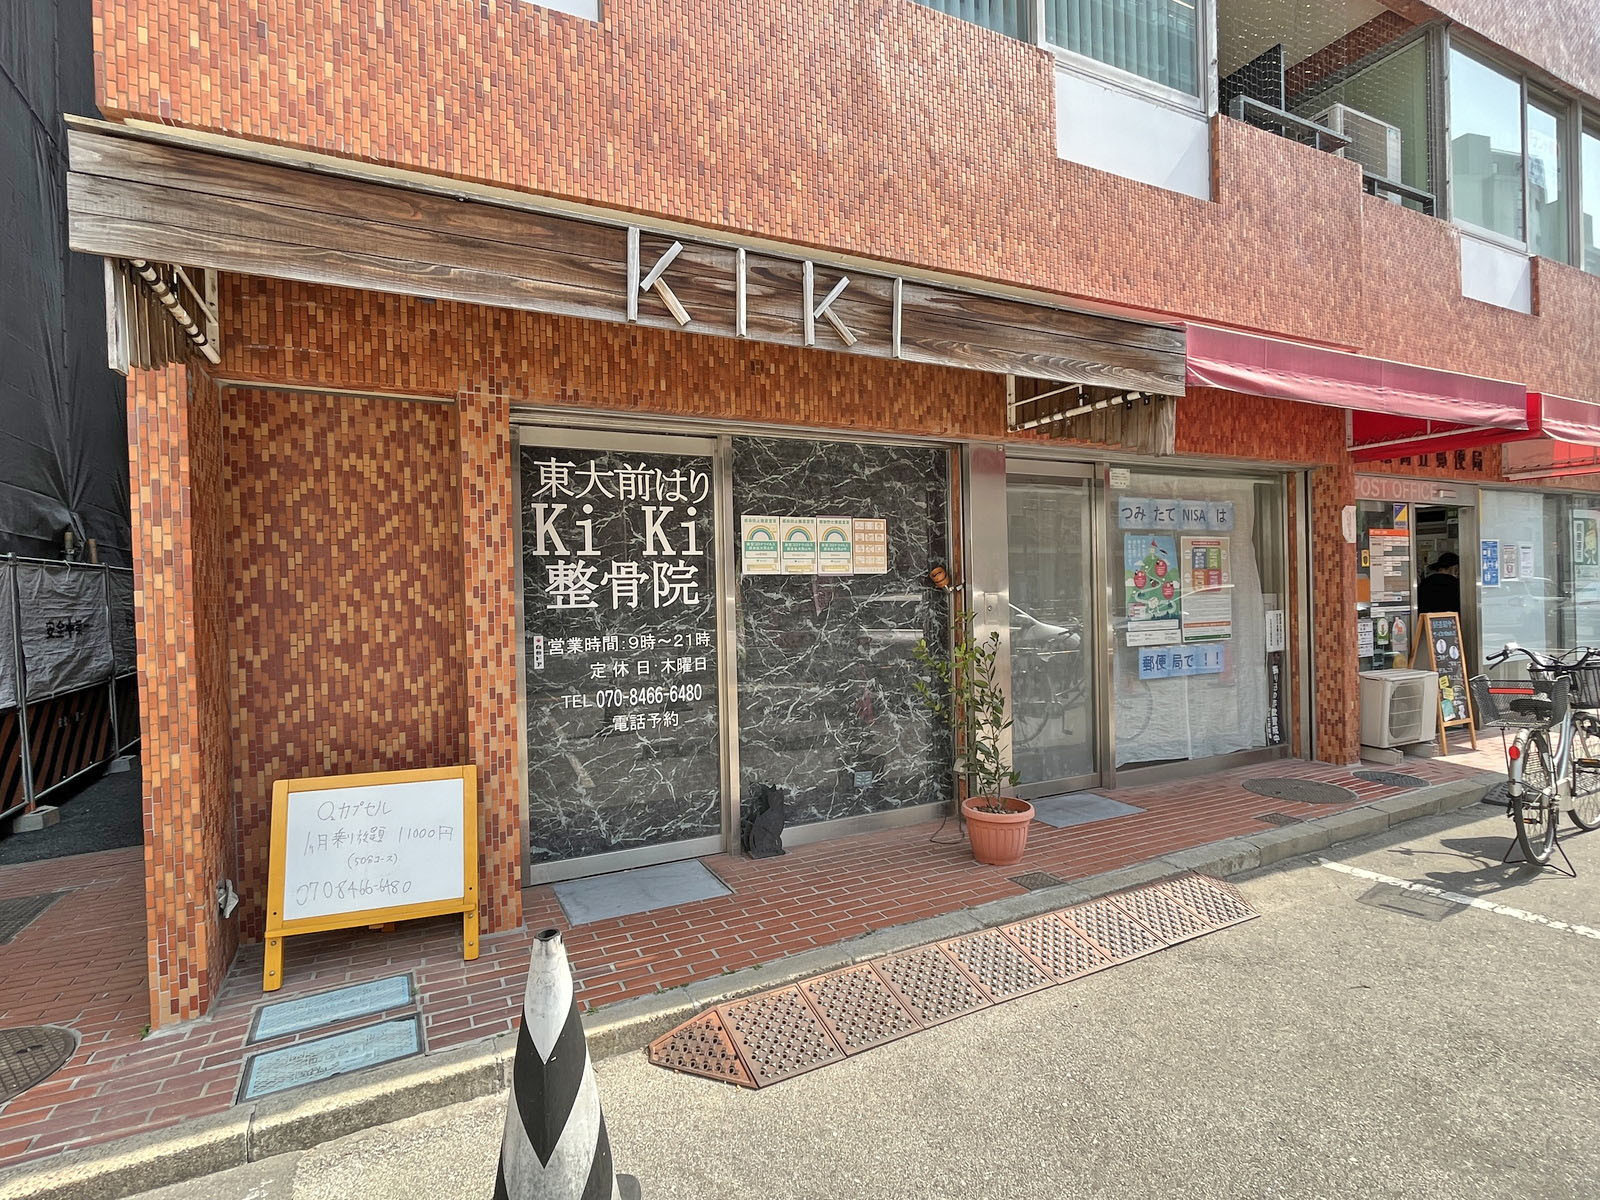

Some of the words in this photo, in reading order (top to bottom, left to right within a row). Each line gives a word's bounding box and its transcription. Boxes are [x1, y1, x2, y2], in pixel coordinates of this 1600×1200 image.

[532, 457, 709, 503] 東大前はり
[1121, 506, 1175, 522] つみたて
[1182, 509, 1206, 522] NISA
[1216, 508, 1227, 523] は
[531, 503, 601, 556] Ki
[641, 506, 704, 556] Ki
[545, 559, 700, 610] 整骨院
[1142, 654, 1194, 671] 郵便局で
[561, 695, 592, 708] TEL
[596, 684, 702, 707] 070-8466-6480
[612, 711, 679, 732] 電話予約
